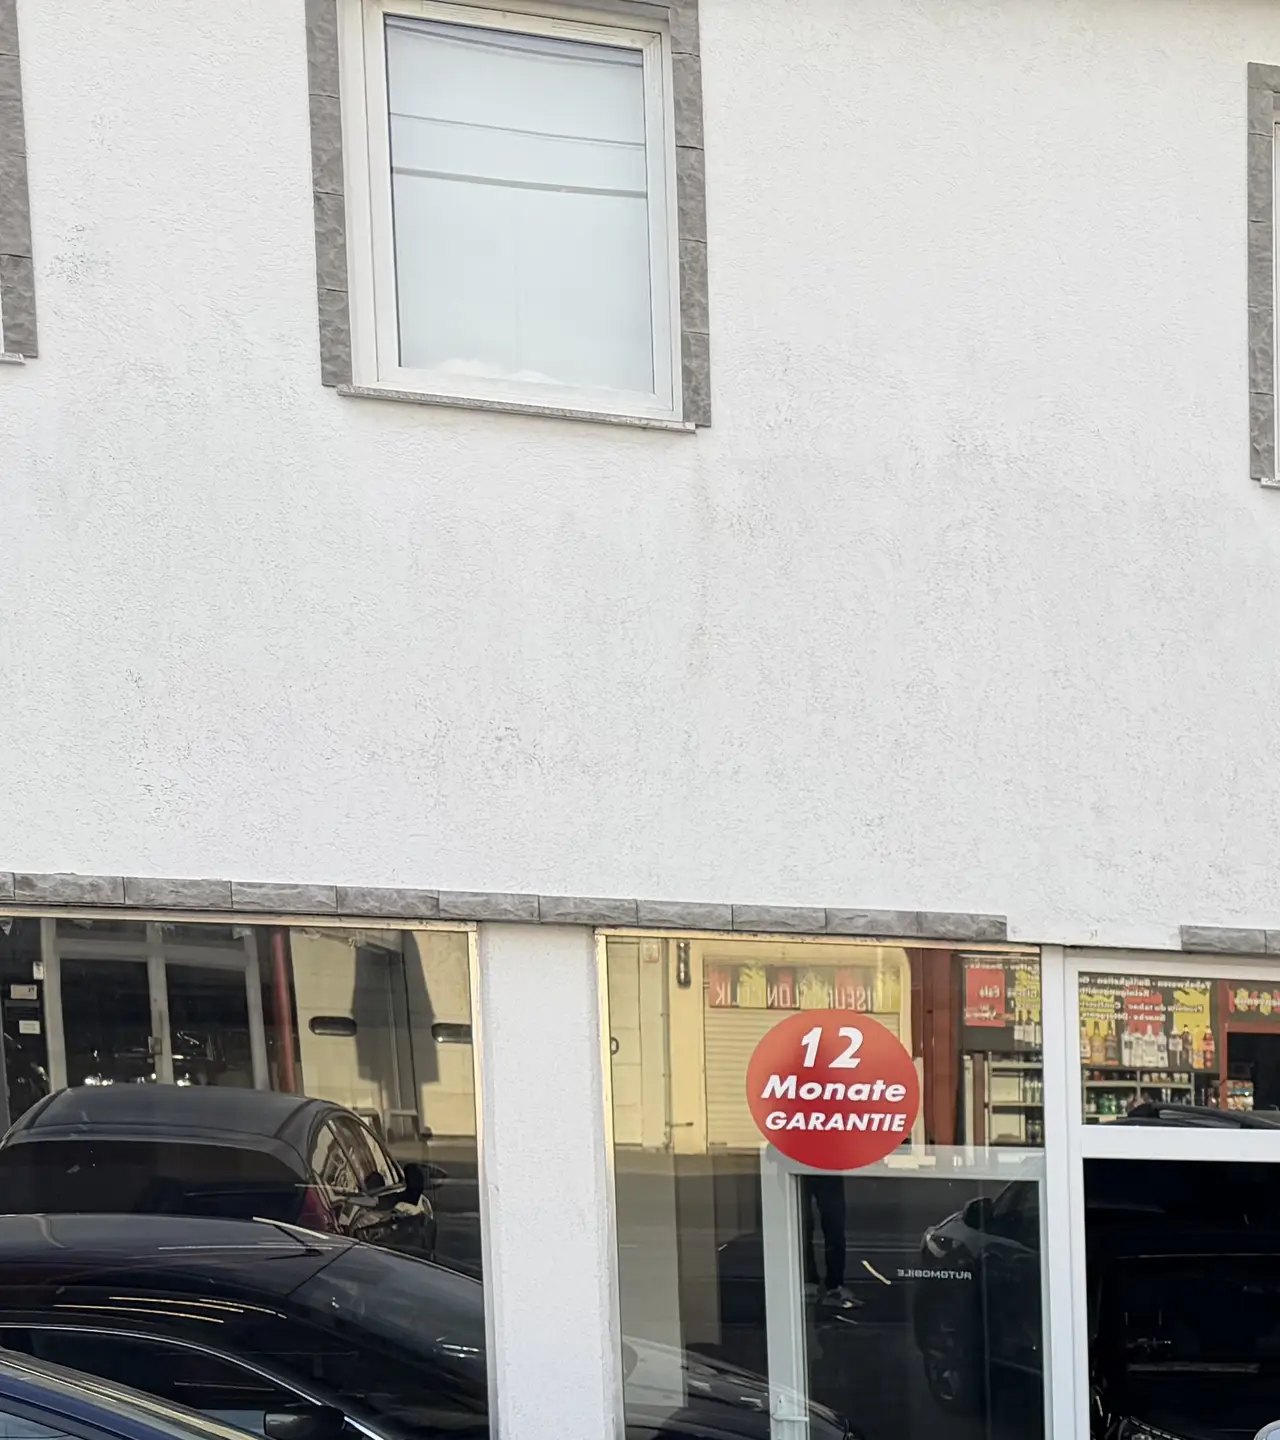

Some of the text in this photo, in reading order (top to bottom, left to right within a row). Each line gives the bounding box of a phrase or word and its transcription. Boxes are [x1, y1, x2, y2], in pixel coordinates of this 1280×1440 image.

[801, 1026, 864, 1069] 12
[761, 1074, 907, 1102] Monate
[765, 1111, 907, 1132] GARANTIE
